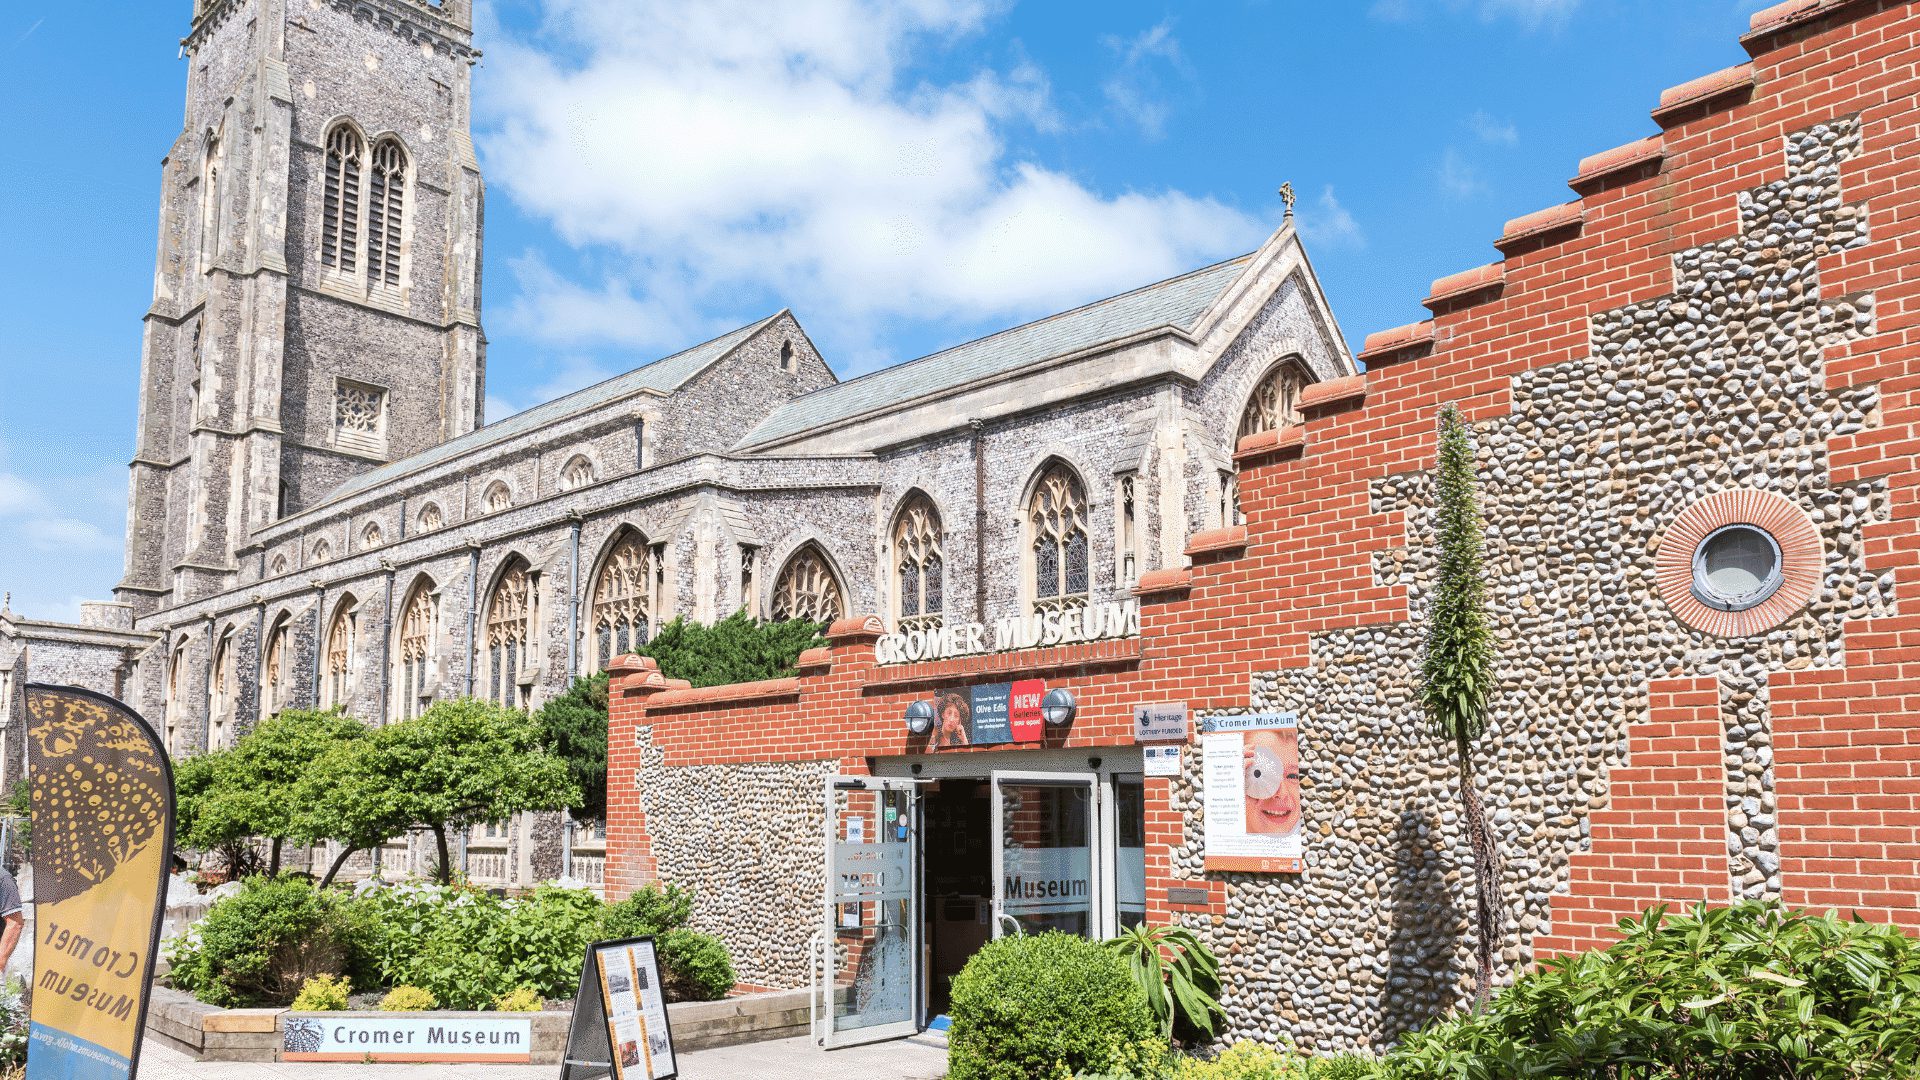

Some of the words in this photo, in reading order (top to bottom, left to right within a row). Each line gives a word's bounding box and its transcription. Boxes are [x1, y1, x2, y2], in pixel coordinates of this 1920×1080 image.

[875, 623, 985, 664] CROMER
[995, 600, 1140, 651] MUSEUM
[1014, 693, 1040, 709] NEW
[976, 704, 992, 714] Olive
[993, 703, 1007, 713] Edis
[1013, 710, 1041, 718] Galleries
[1154, 713, 1182, 723] Heritage
[1219, 719, 1250, 728] Cromer
[1255, 717, 1294, 726] Museum
[1161, 727, 1183, 735] FUNDED
[1005, 876, 1088, 899] Museum
[333, 1025, 415, 1045] Cromer
[427, 1026, 520, 1045] Museum
